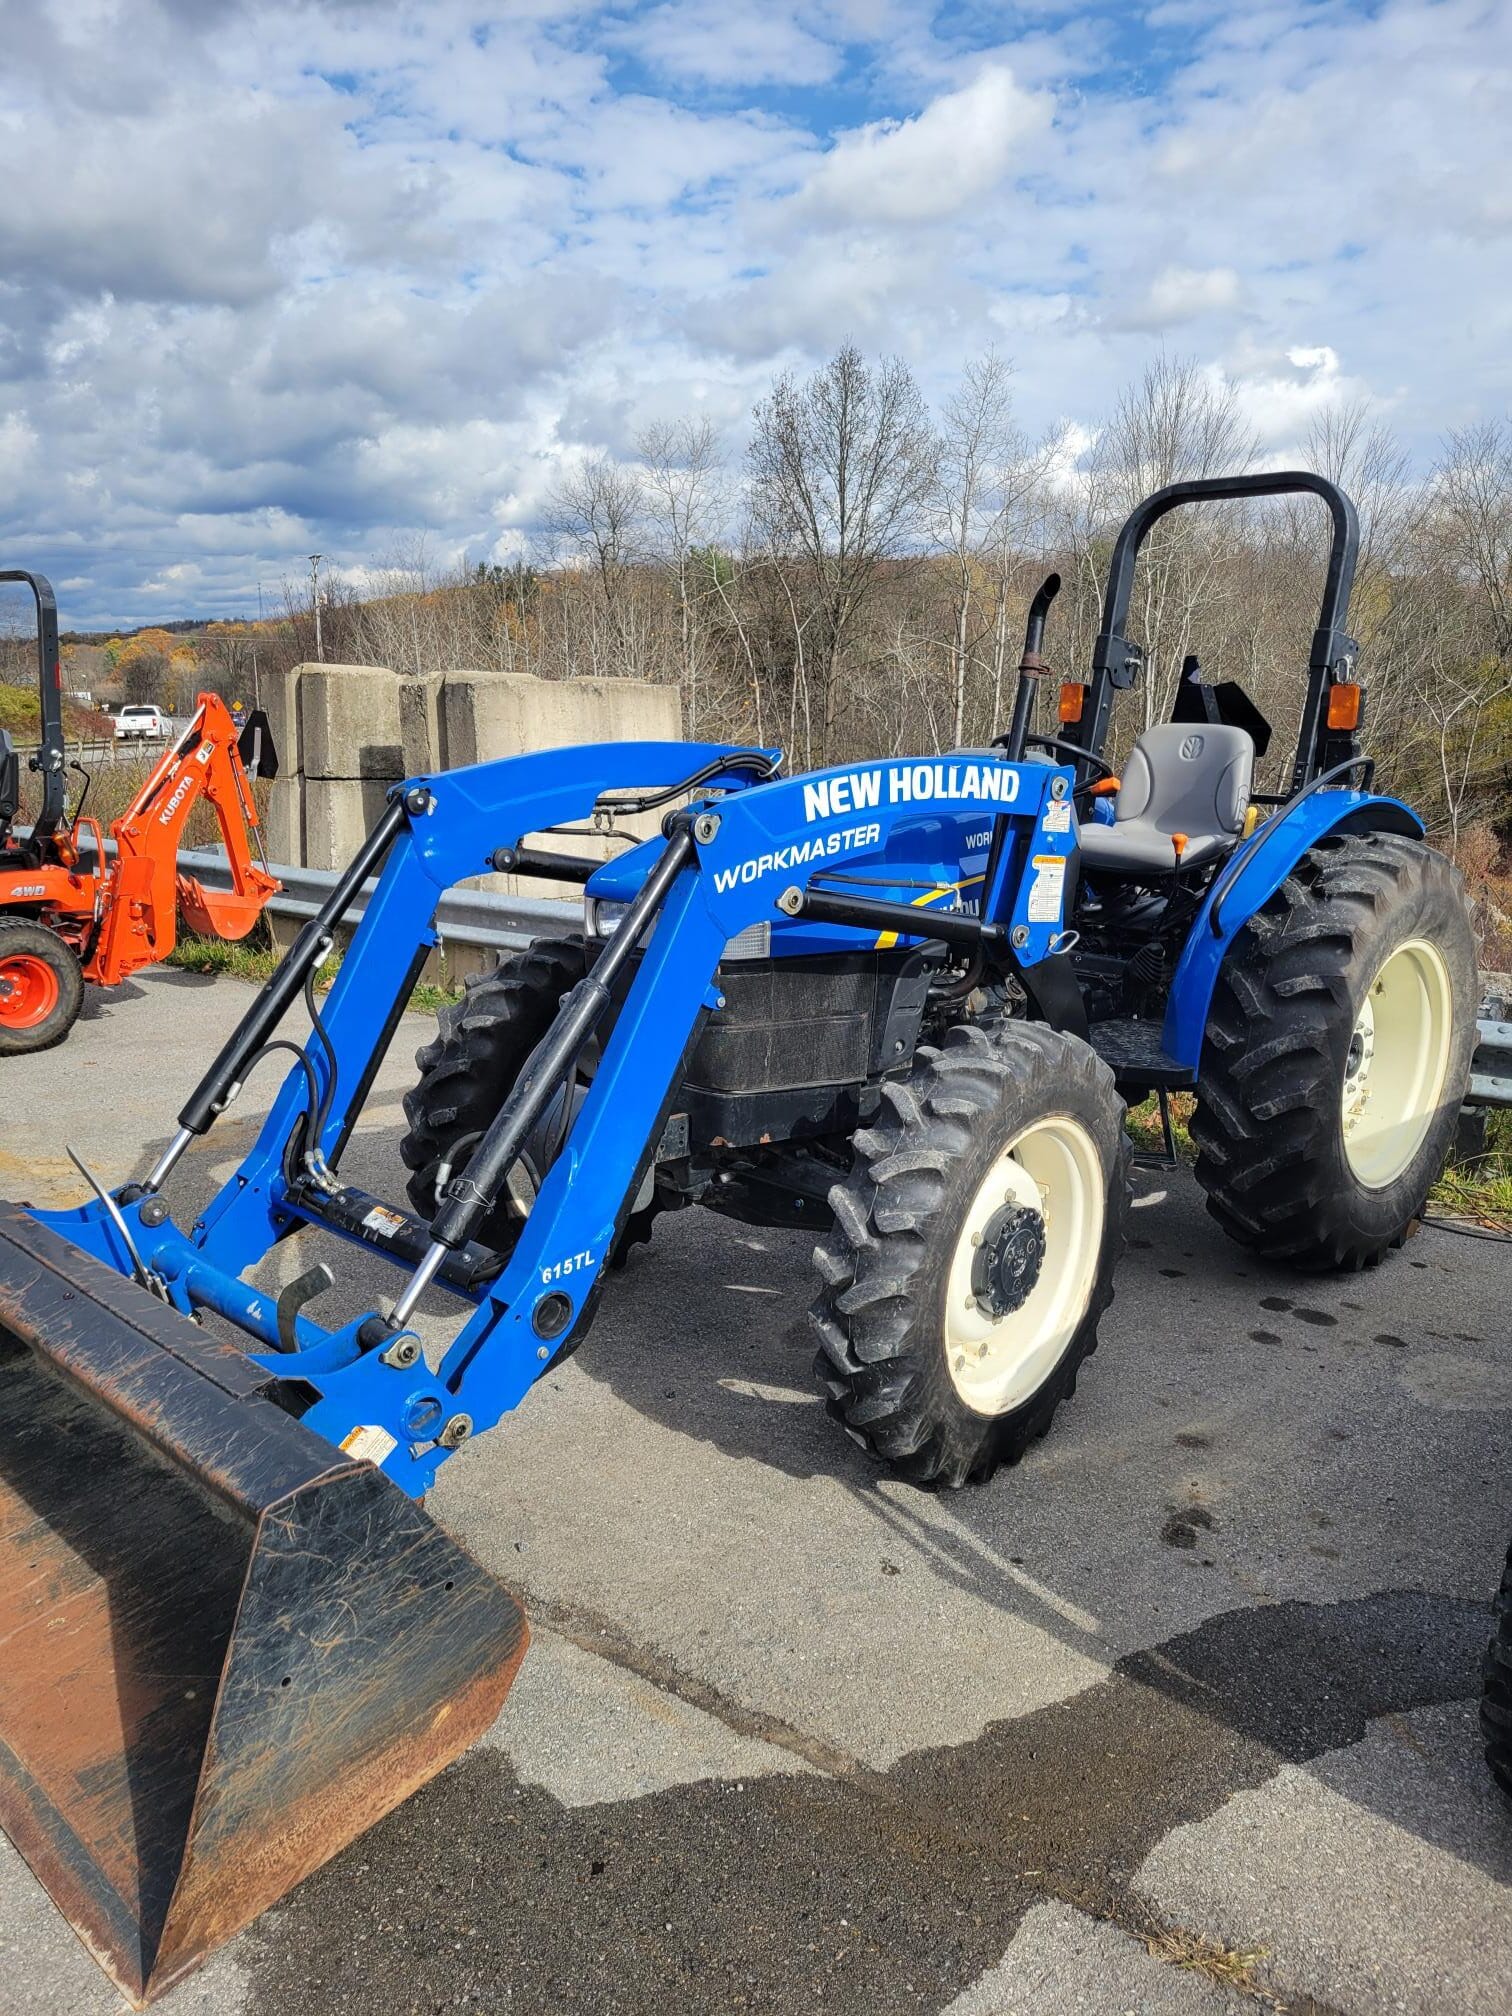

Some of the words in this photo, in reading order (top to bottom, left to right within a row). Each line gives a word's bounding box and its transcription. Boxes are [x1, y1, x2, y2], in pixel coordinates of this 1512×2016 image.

[159, 776, 194, 826] KUBOTA
[803, 769, 882, 823] NEW
[889, 764, 1020, 803] HOLLAND
[713, 823, 881, 894] WORKMASTER
[10, 885, 46, 897] 4WD
[542, 1249, 595, 1284] 615TL
